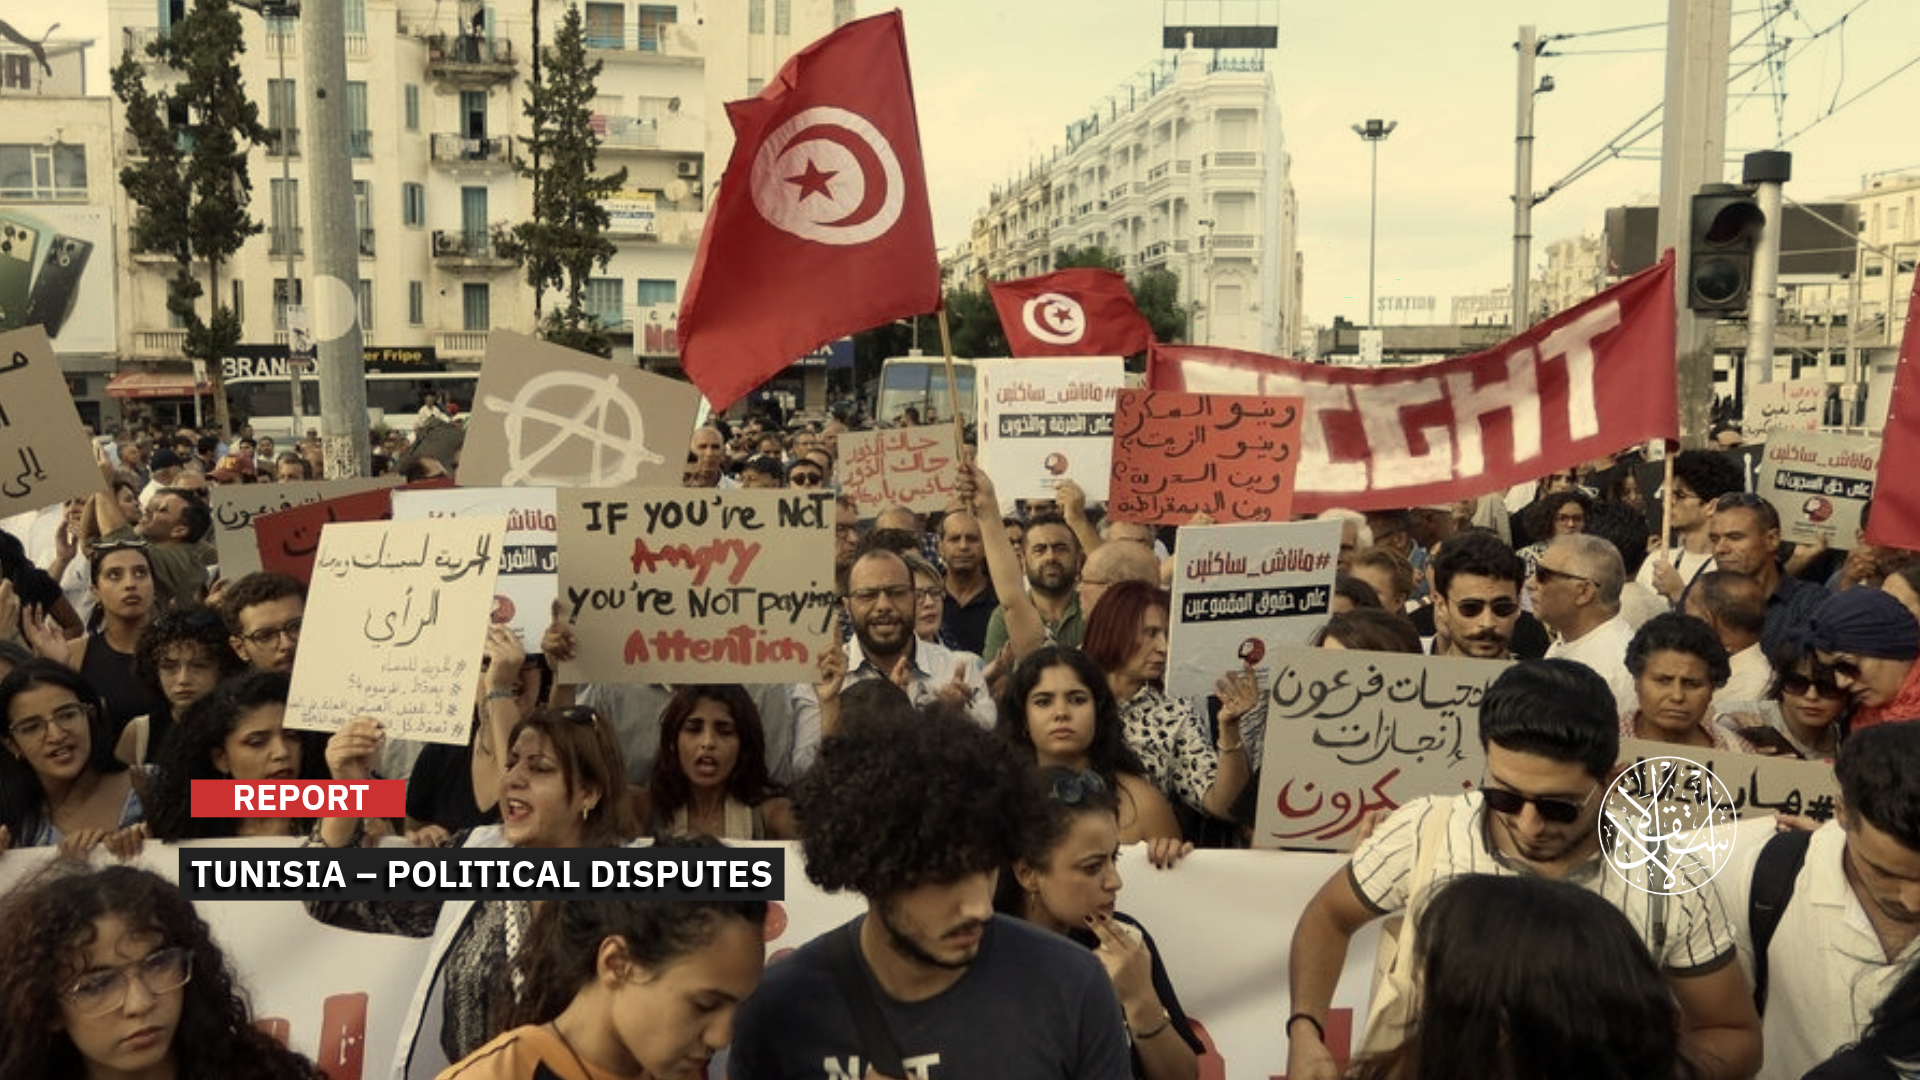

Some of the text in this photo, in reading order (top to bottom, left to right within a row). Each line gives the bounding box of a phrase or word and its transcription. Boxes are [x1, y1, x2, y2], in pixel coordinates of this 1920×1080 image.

[1181, 300, 1620, 493] IGHT
[582, 502, 628, 535] IF
[1185, 587, 1326, 621] على حقوق المقموعين
[1272, 664, 1385, 720] فرعون
[1312, 708, 1466, 769] إنجازات
